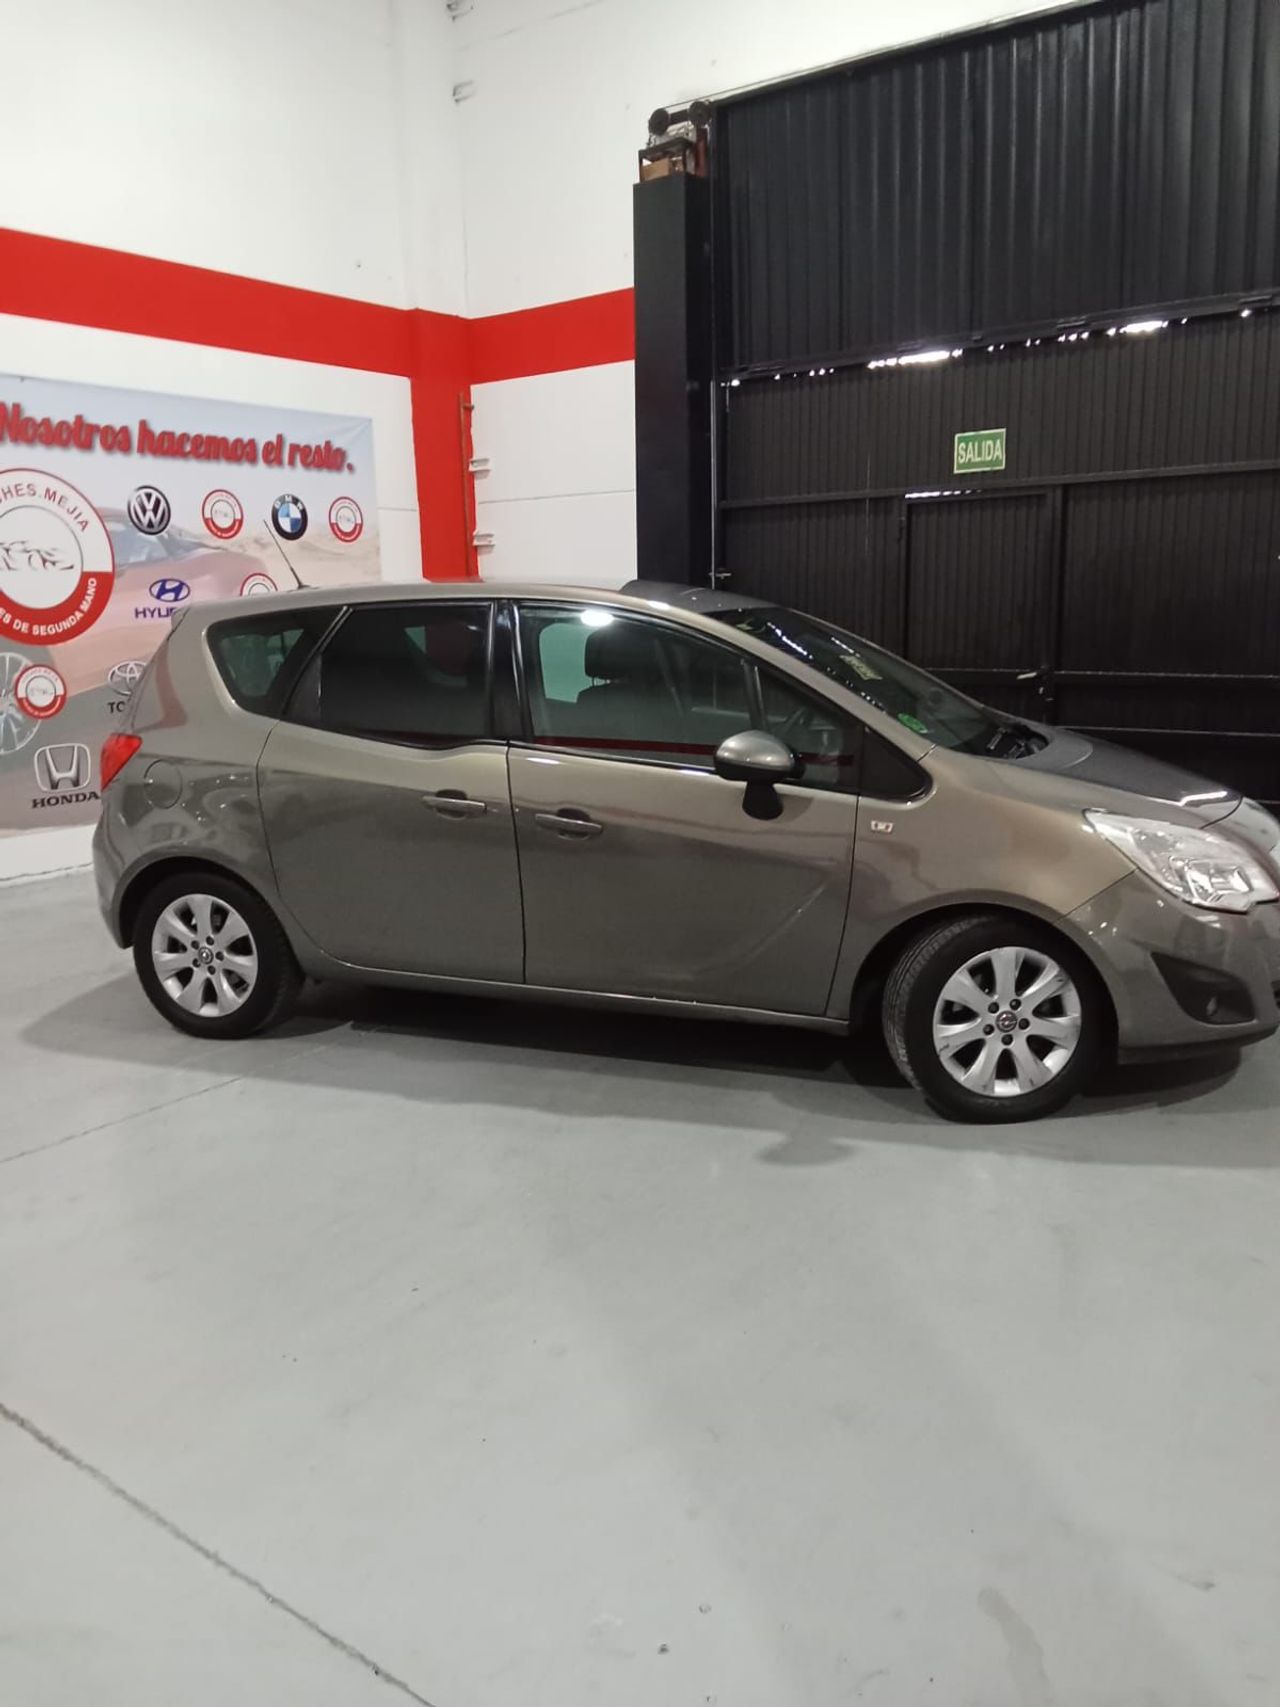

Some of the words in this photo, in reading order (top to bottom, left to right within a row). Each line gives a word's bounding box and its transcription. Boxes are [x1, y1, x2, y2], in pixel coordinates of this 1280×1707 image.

[0, 401, 131, 454] Nosotros
[136, 418, 258, 465] hacemos
[262, 433, 284, 466] el
[288, 439, 353, 473] resto.
[958, 439, 1003, 463] SALIDA
[12, 619, 30, 633] DE
[32, 610, 84, 636] SEGUNDA
[79, 577, 97, 612] MANO
[31, 791, 101, 809] HONDA
